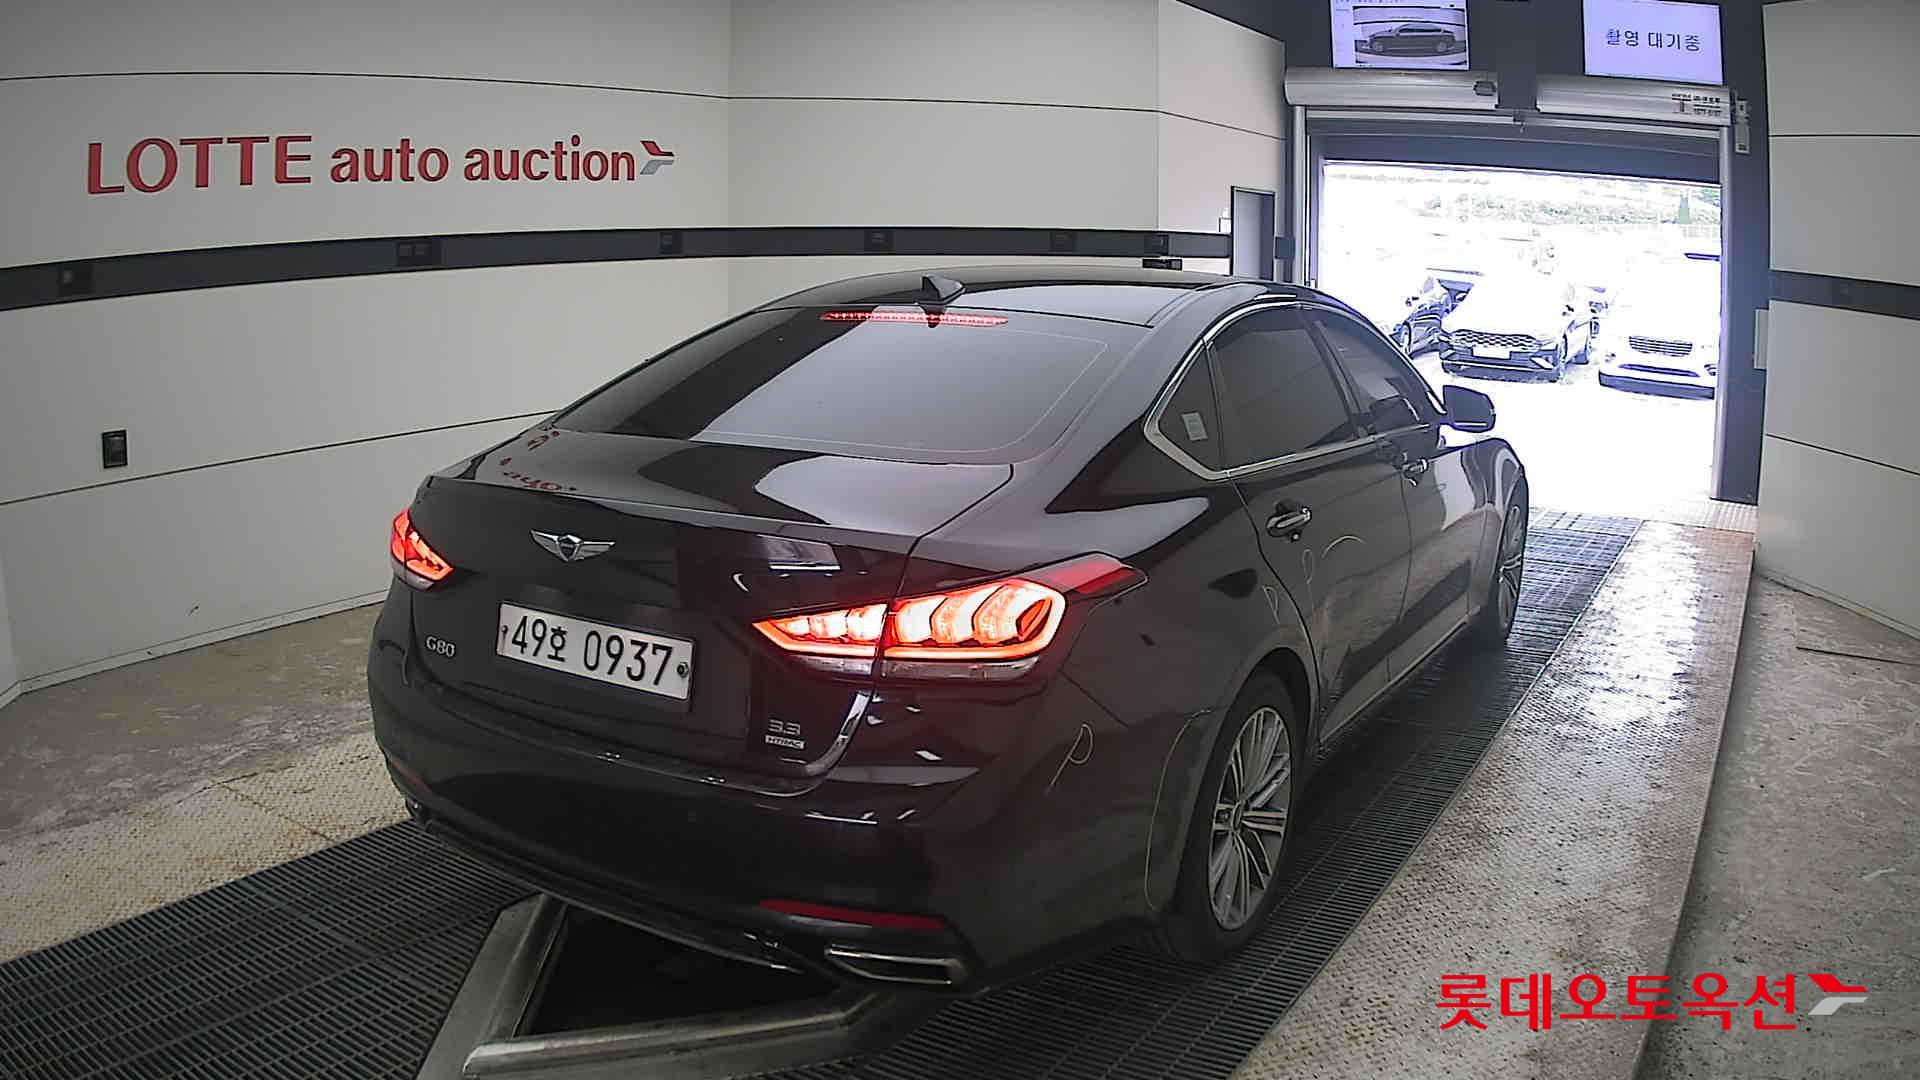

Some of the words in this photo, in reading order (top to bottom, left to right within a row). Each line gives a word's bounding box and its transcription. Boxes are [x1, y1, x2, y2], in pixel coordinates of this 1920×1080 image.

[1607, 29, 1639, 47] 촬영
[1648, 32, 1700, 51] 대기중
[87, 135, 313, 194] LOTTE
[330, 138, 449, 183] auto
[463, 135, 637, 182] auction
[426, 636, 455, 657] G80
[511, 615, 567, 662] 49호
[583, 630, 673, 686] 0937
